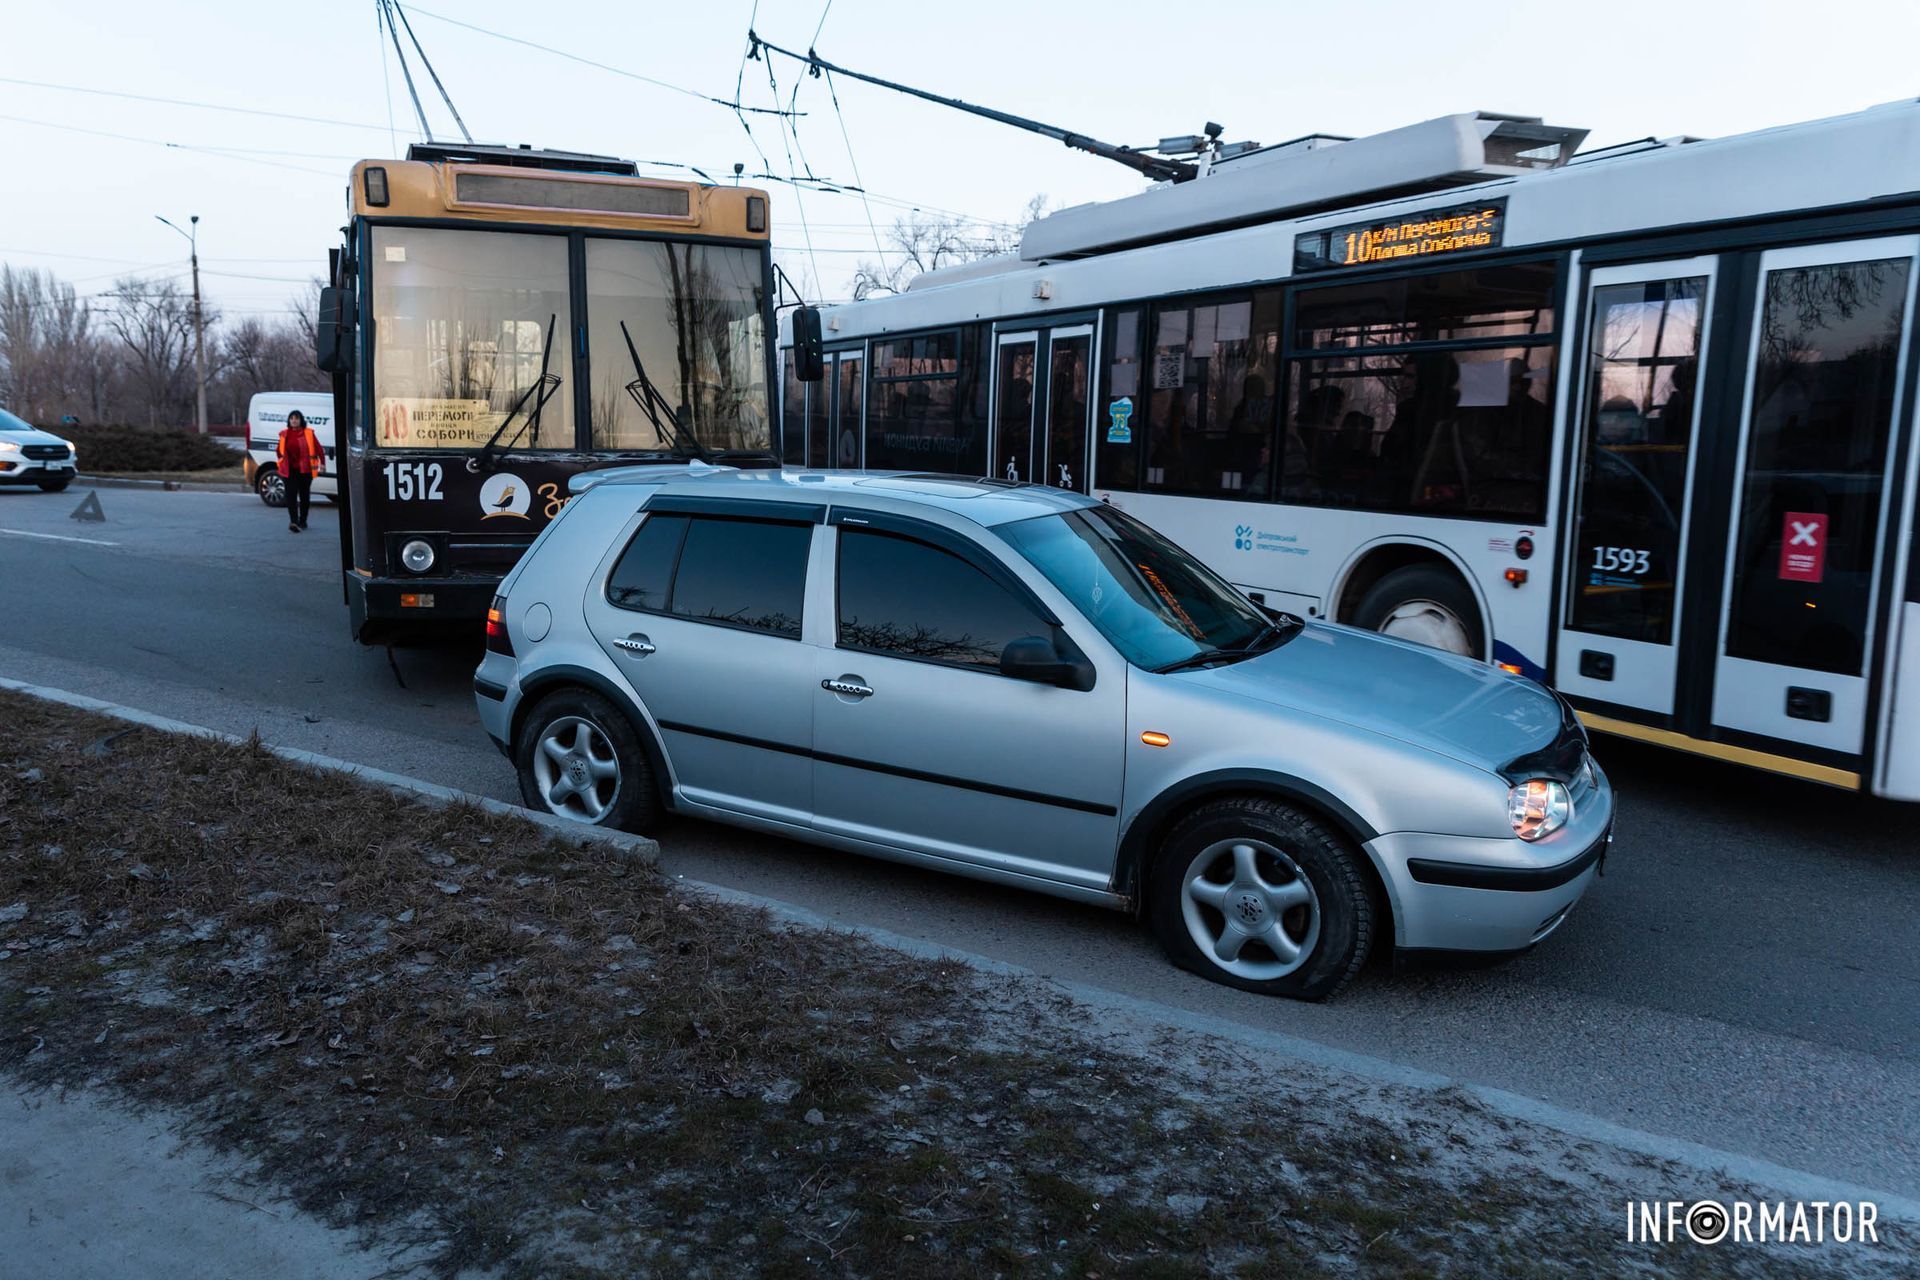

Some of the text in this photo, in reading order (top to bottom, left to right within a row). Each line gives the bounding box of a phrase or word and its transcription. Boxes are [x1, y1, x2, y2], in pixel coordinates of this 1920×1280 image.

[1344, 232, 1371, 264] 10
[383, 403, 409, 440] 10
[383, 462, 444, 500] 1512
[1592, 546, 1651, 574] 1593
